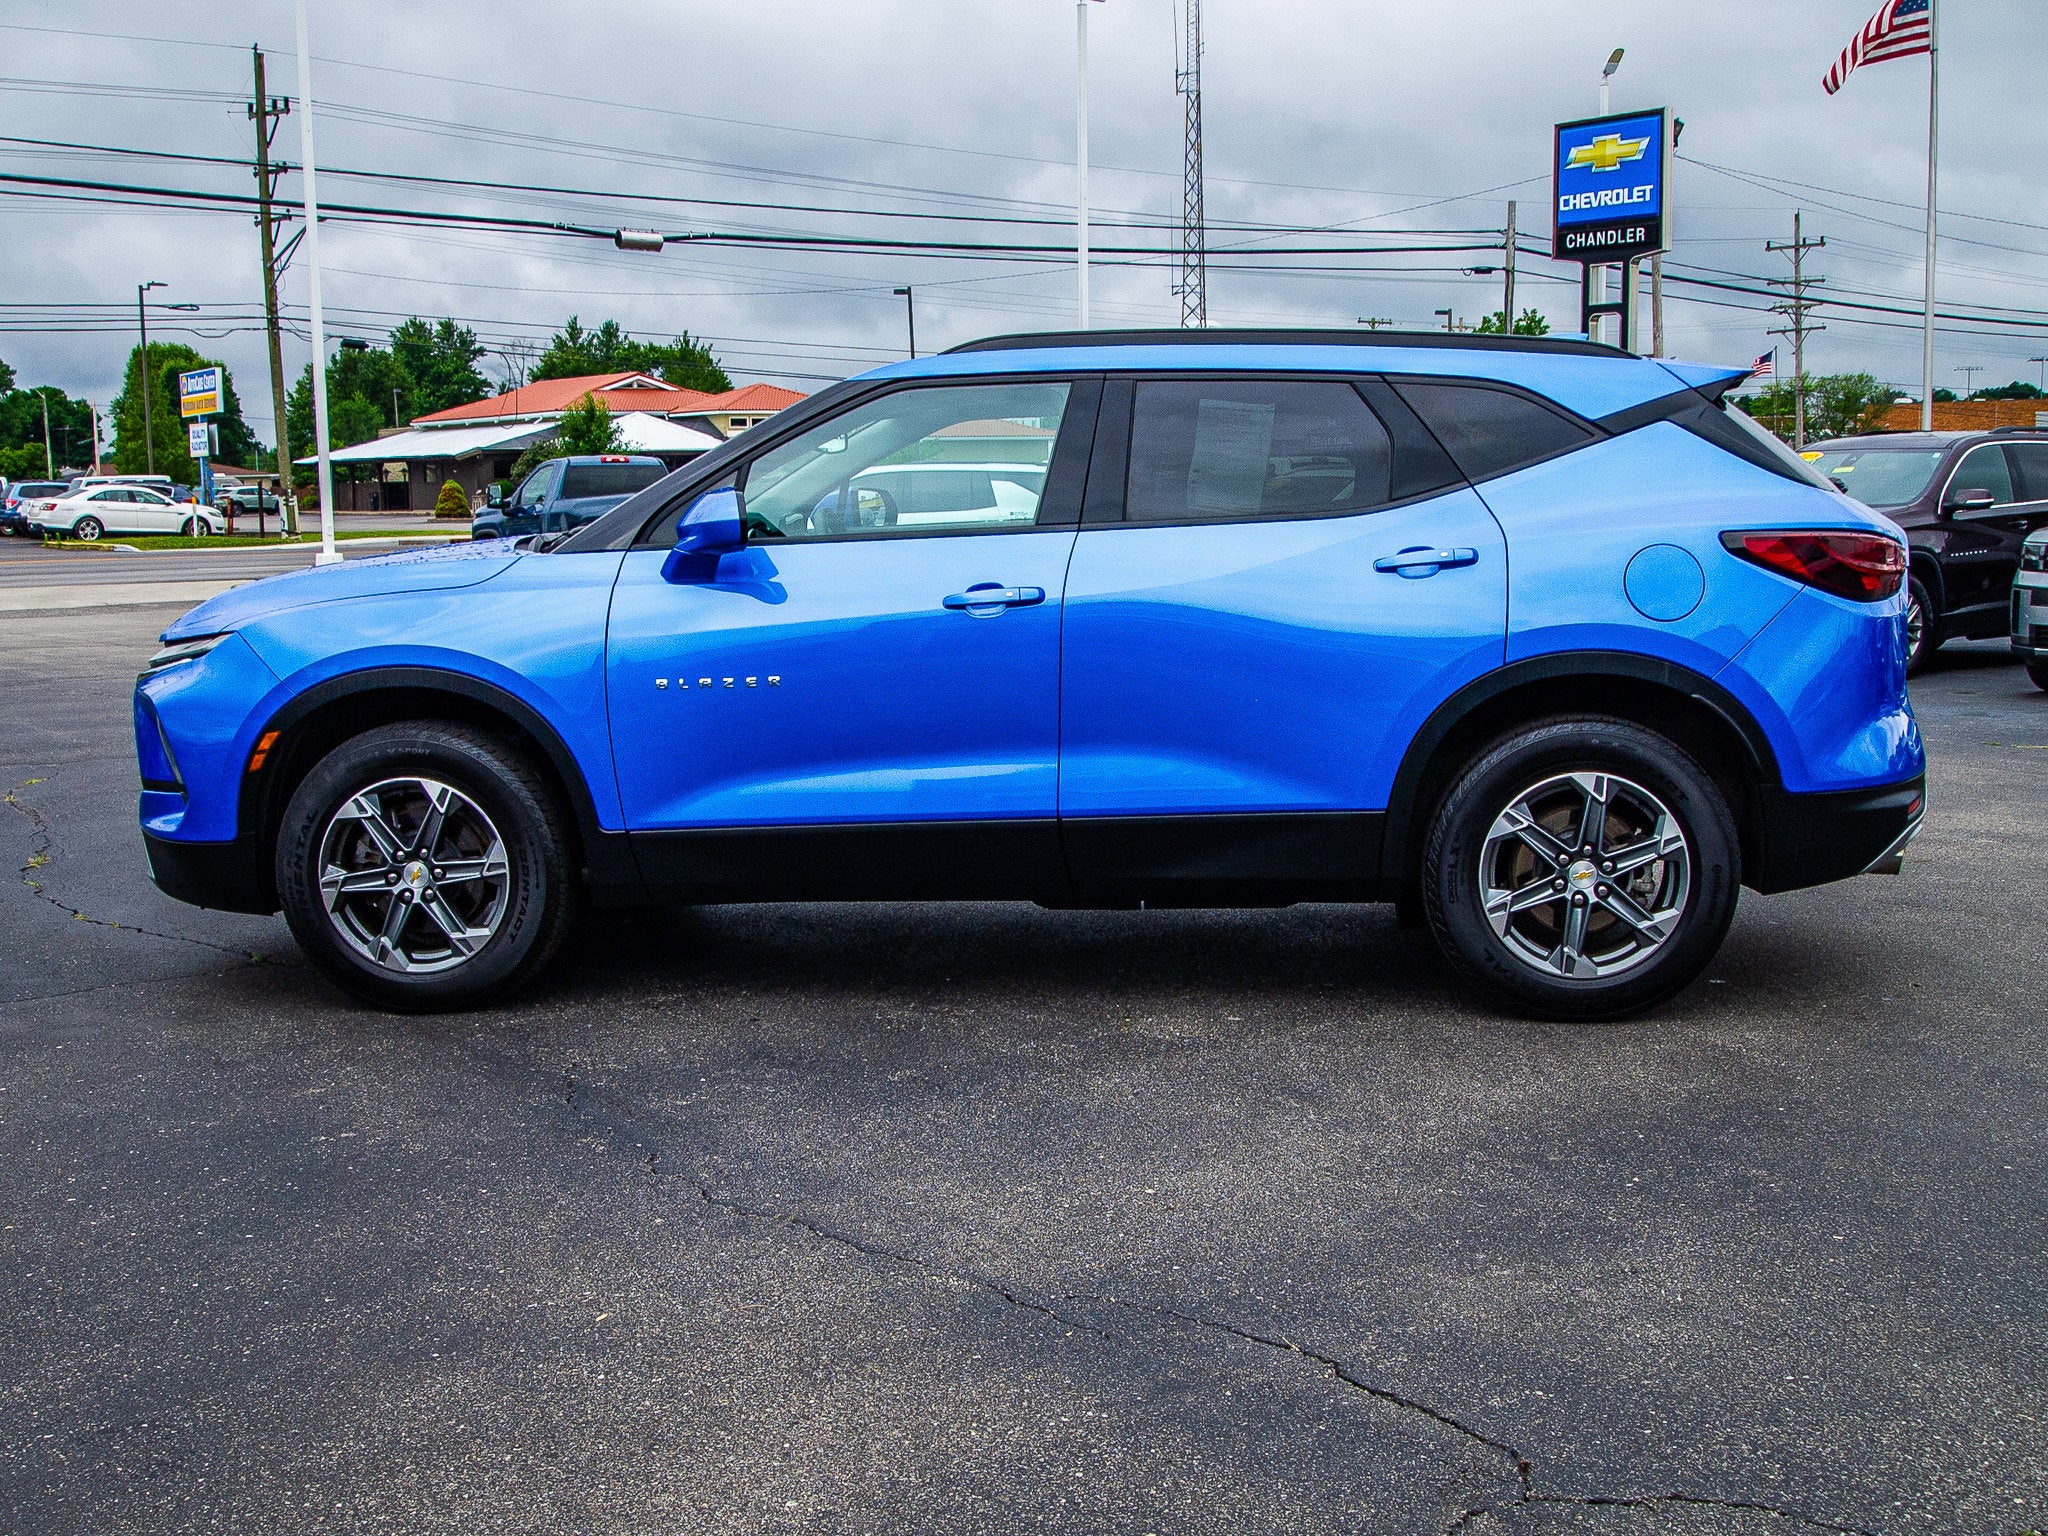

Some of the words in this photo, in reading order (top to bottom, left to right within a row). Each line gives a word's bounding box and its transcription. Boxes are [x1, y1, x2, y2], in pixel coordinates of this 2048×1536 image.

[1559, 184, 1654, 211] CHEVROLET
[1566, 227, 1646, 248] CHANDLER
[655, 675, 781, 690] BLAZER
